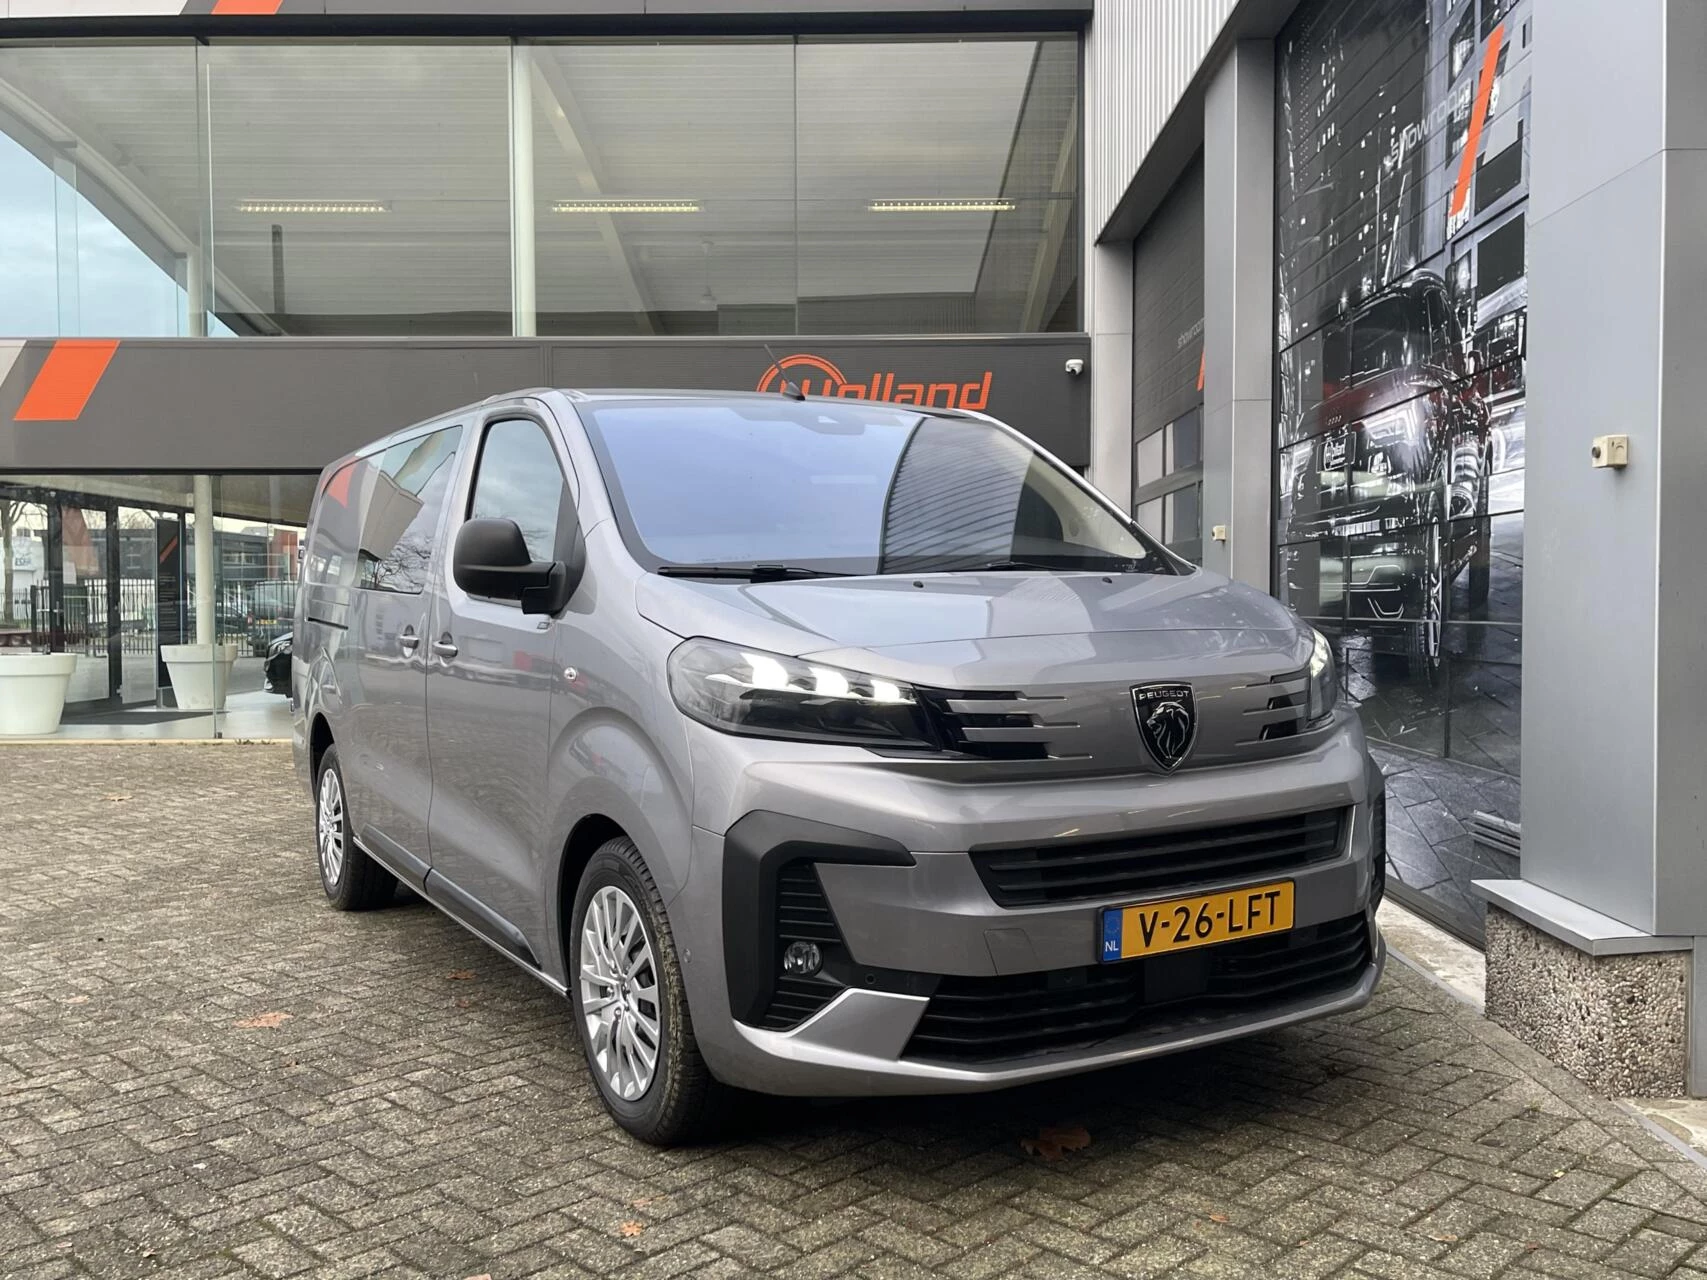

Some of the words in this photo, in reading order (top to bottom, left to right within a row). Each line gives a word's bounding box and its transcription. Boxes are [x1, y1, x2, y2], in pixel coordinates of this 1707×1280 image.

[1138, 690, 1190, 701] PEUGEOT
[1138, 890, 1281, 948] V-26-LFT
[1104, 940, 1119, 952] NL
